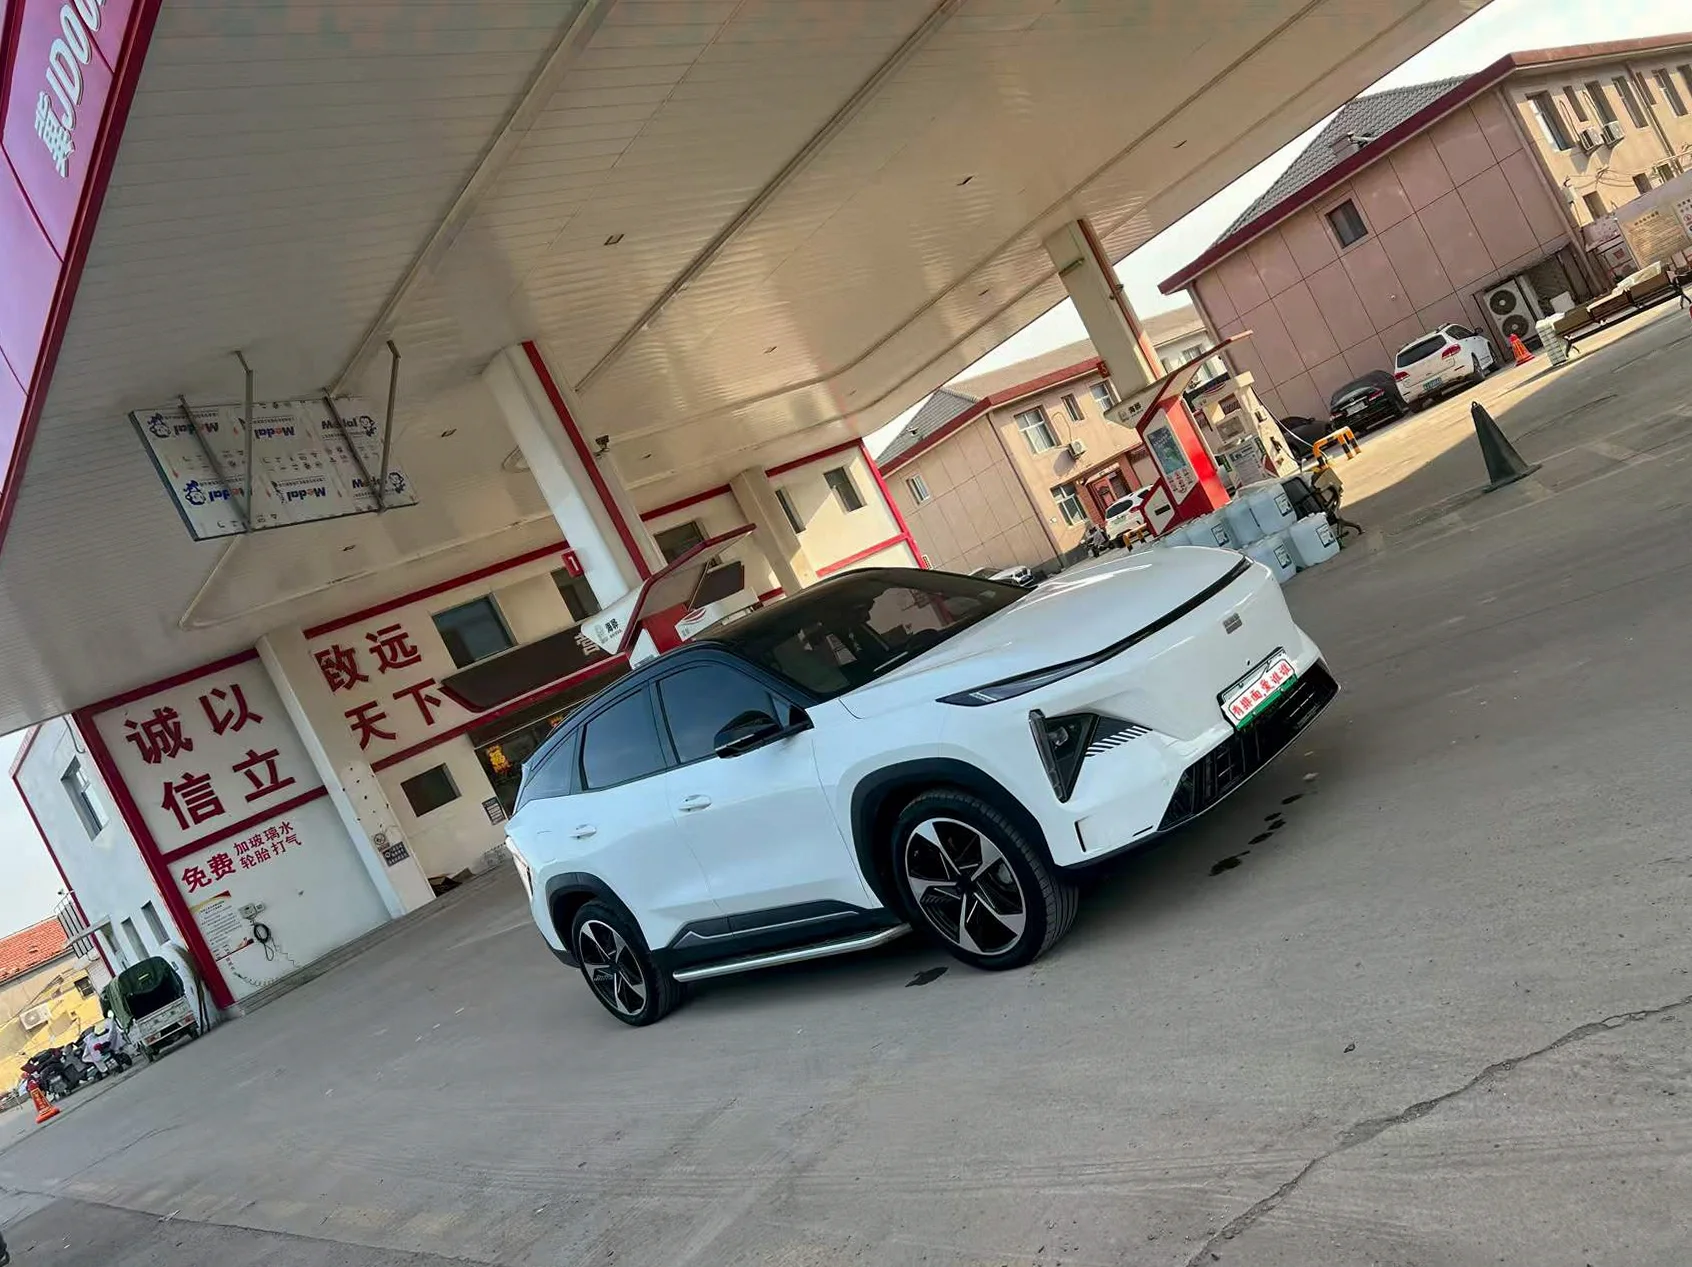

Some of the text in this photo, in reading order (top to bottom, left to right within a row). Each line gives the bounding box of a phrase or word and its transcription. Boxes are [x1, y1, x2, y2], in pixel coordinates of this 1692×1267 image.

[254, 426, 295, 439] Medal
[287, 487, 326, 502] Medal
[568, 556, 580, 571] 1
[124, 684, 263, 764] 诚以
[344, 678, 441, 750] 天下
[161, 748, 296, 830] 信立
[233, 821, 294, 856] 加玻璃水
[240, 833, 302, 869] 轮胎打气
[181, 852, 236, 893] 免费
